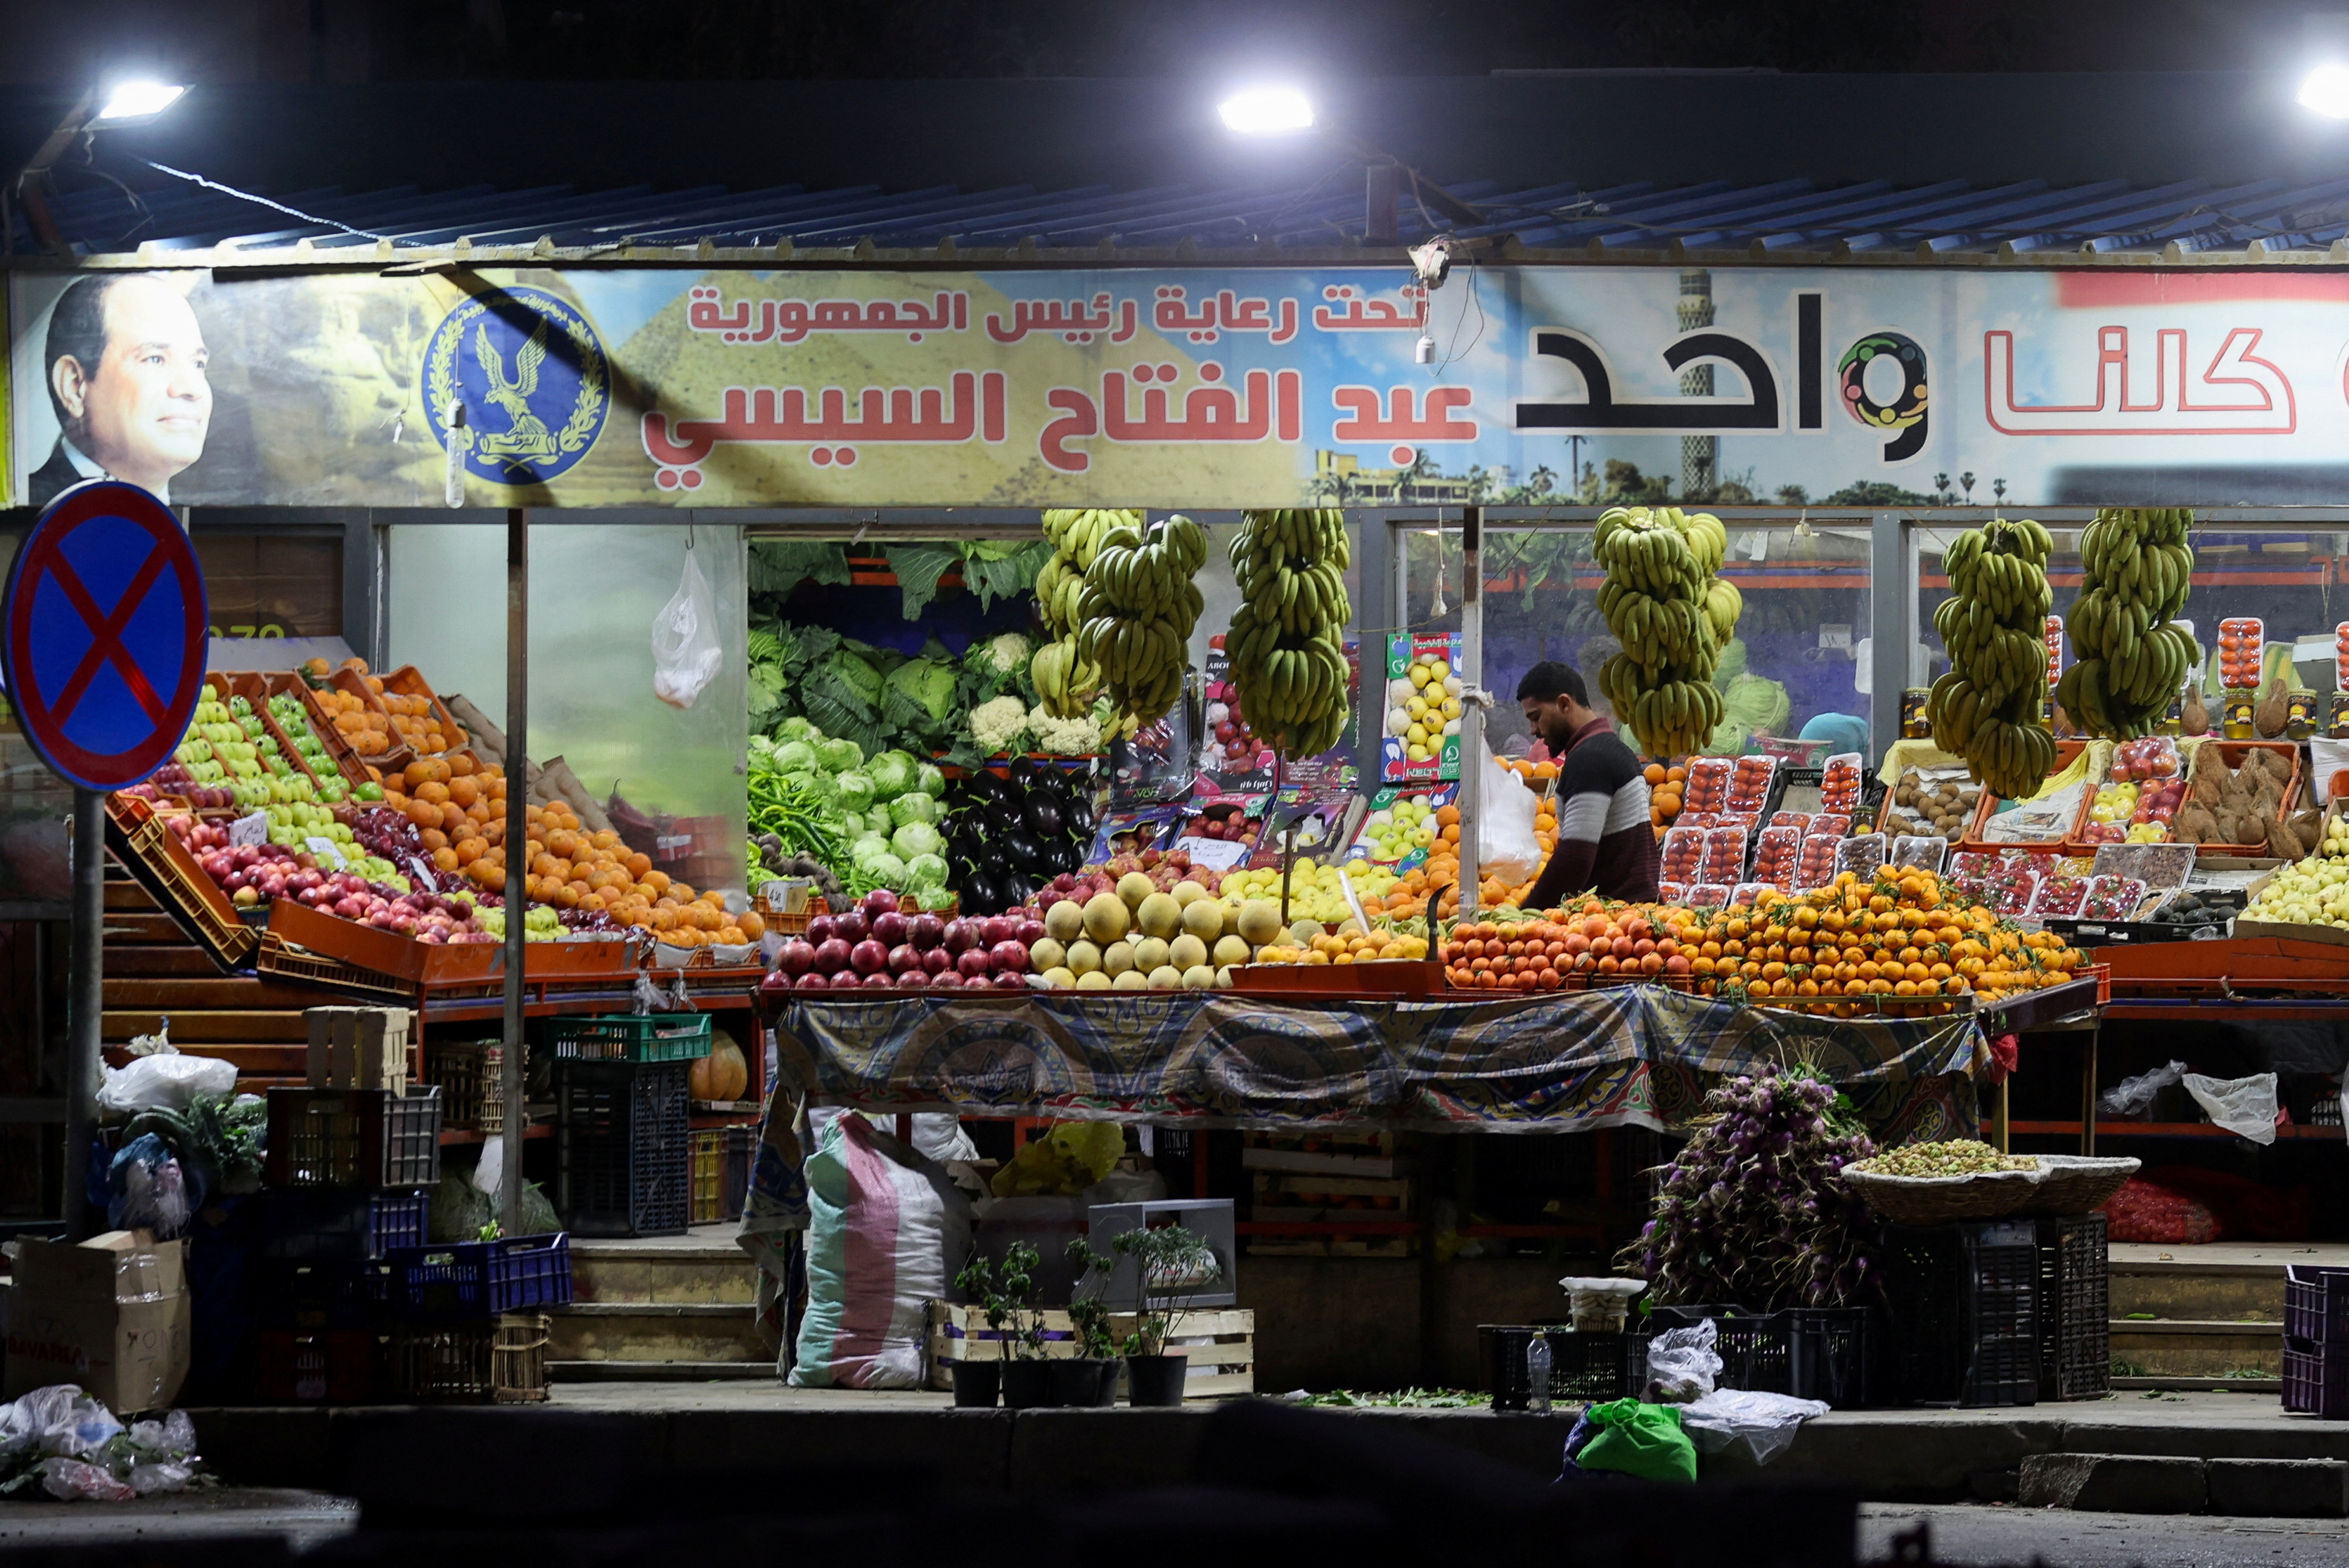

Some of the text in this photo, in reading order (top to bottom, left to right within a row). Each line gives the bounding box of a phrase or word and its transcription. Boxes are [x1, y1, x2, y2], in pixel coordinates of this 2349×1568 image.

[688, 285, 1430, 342] تحت رعاية رئيس الجمهورية
[642, 362, 1478, 489] عبد الفتاح السيسي
[1516, 293, 2297, 462] كلنا واحد
